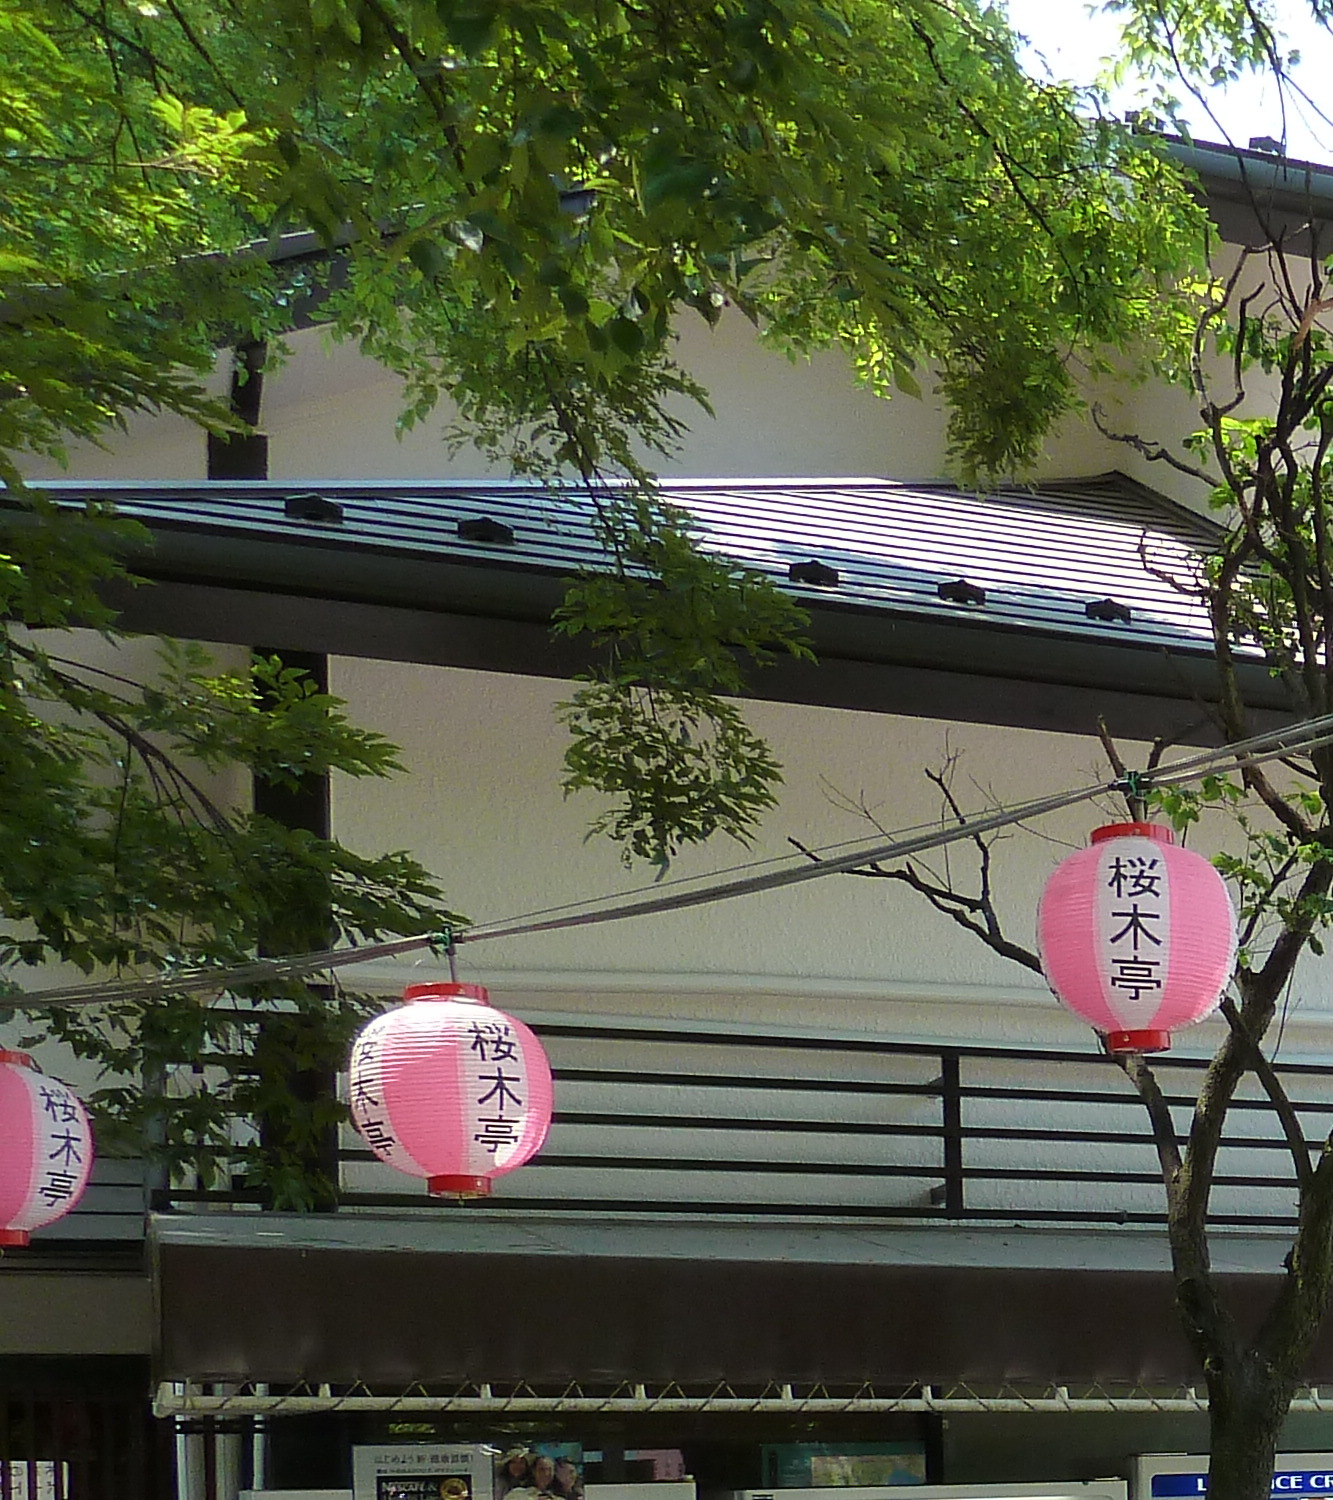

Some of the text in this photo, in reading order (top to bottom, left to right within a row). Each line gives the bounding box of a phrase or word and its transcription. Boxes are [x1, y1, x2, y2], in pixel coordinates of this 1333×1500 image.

[1107, 857, 1163, 1002] 桜木亭
[39, 1084, 83, 1208] 桜木亭
[470, 1022, 522, 1154] 桜木亭
